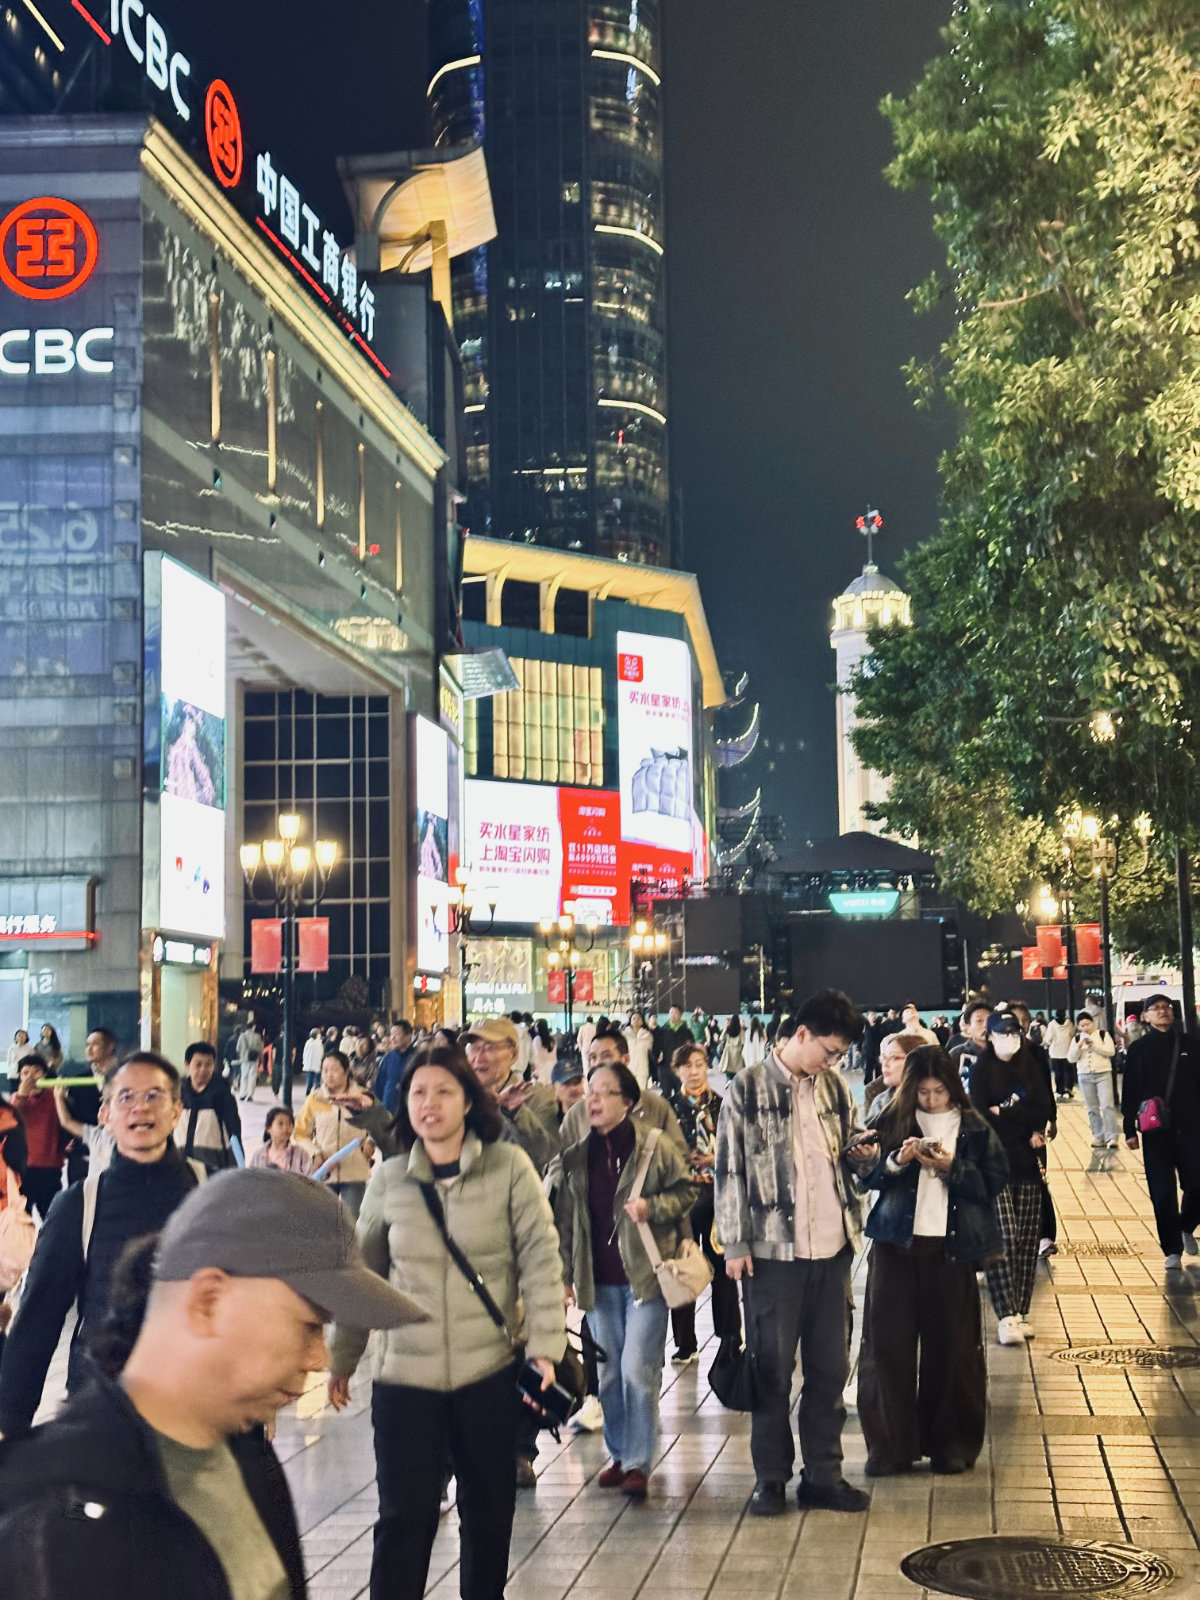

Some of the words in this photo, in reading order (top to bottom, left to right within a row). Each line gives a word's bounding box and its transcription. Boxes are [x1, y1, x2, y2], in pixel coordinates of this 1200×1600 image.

[110, 0, 191, 121] ICBC
[256, 150, 376, 342] 中国工商银行
[0, 327, 114, 375] CBC
[480, 822, 550, 843] 买水星家纺
[480, 844, 551, 864] 上淘宝闪购
